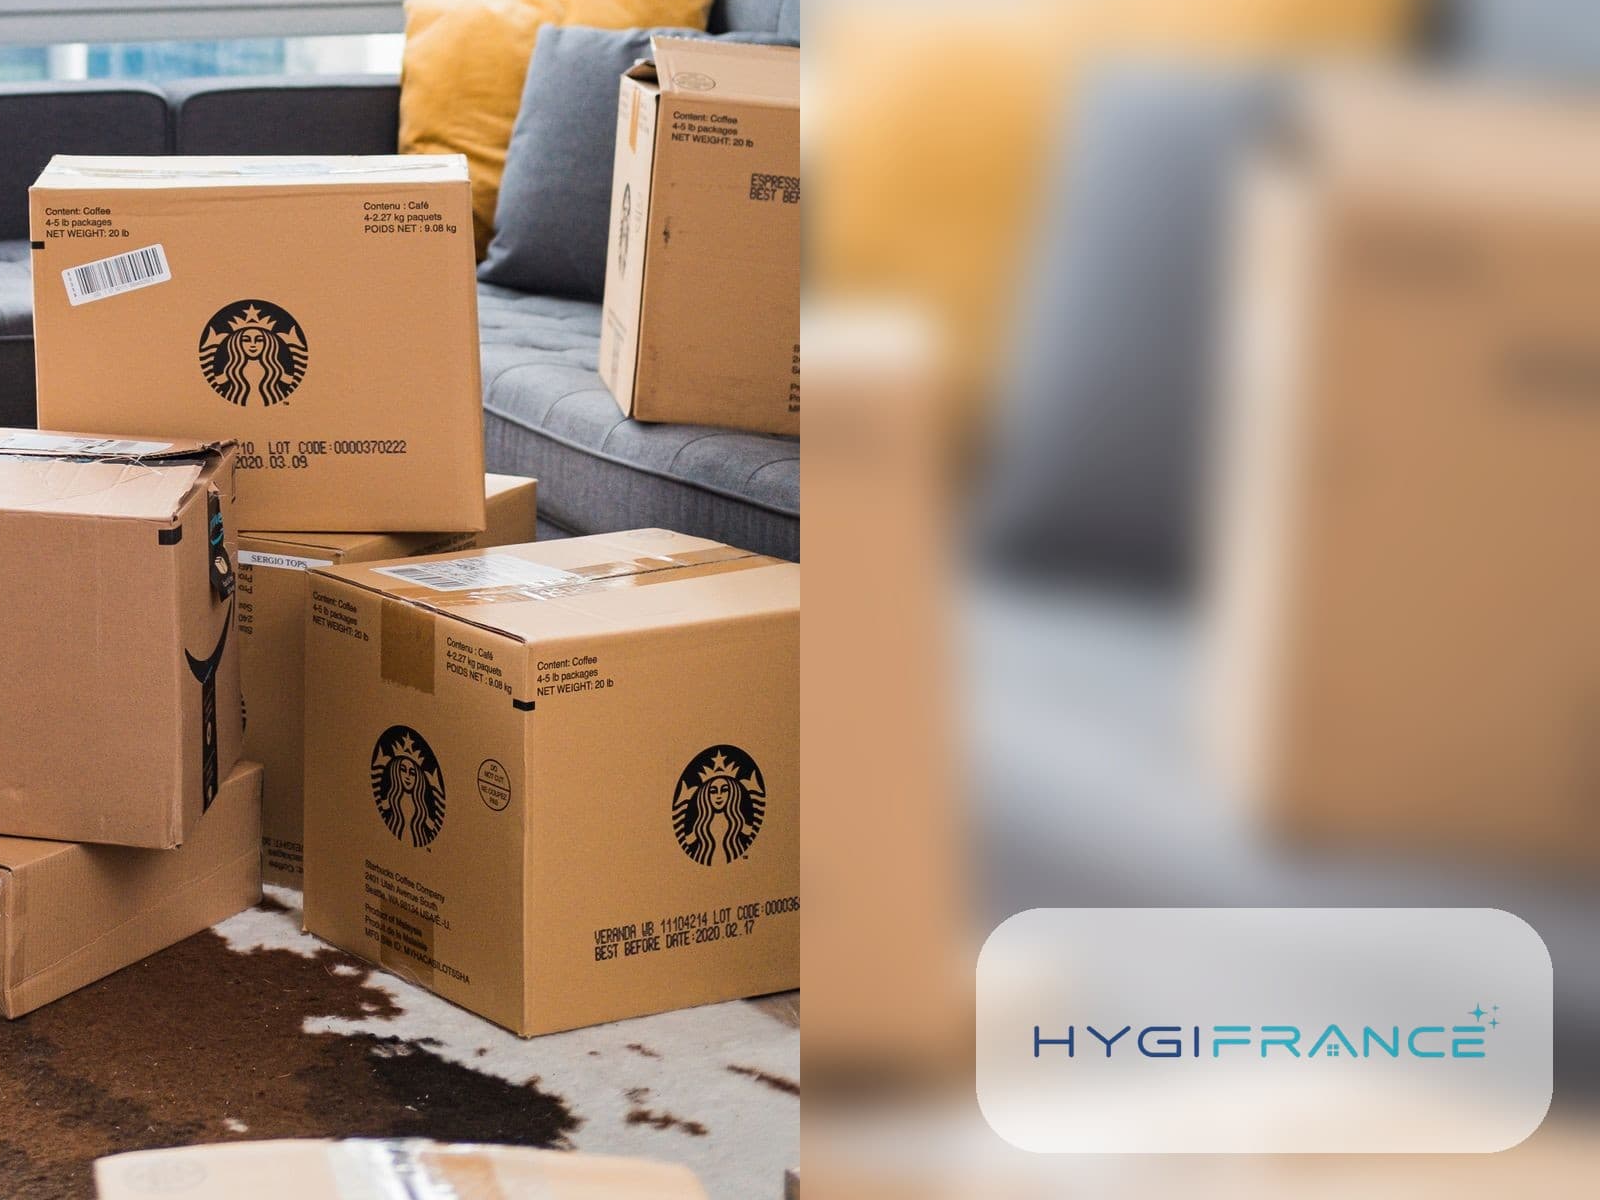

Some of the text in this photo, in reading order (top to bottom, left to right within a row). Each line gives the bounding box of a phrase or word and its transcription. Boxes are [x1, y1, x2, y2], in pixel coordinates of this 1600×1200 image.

[673, 111, 738, 124] Content: Coffee
[688, 123, 695, 132] lb
[698, 125, 738, 135] packages
[672, 133, 690, 141] NET
[733, 138, 743, 147] 20
[746, 139, 754, 148] lb
[750, 173, 800, 190] ESPRESS
[750, 187, 777, 201] BEST
[45, 207, 111, 216] Content: Coffee
[363, 202, 401, 211] Contenu
[408, 201, 429, 210] Café
[45, 219, 112, 228] 4-5 lb packages
[363, 213, 442, 223] 4-2.27 kg paquets
[46, 229, 129, 238] NET WEIGHT: 20 lb
[364, 224, 395, 233] POIDS
[397, 224, 416, 233] NET
[424, 224, 444, 233] 9.08
[446, 224, 457, 234] kg
[268, 441, 290, 455] LOT
[299, 440, 407, 455] CODE:0000370222
[251, 554, 308, 569] SERGIO TOPS
[447, 636, 473, 654] Contenu
[478, 648, 493, 660] Café
[447, 650, 502, 677] 4-2.27 kg paquets
[537, 655, 598, 671] Content: Coffee
[447, 661, 468, 677] POIDS
[470, 670, 483, 682] NET
[489, 677, 503, 690] 9.08
[504, 682, 512, 695] kg
[537, 668, 599, 683] 4-5 lb packages
[537, 677, 614, 697] NET WEIGHT: 20 lb
[395, 872, 415, 888] Coffee
[416, 882, 445, 904] Company
[420, 896, 438, 911] South
[594, 924, 637, 945] VERANDA
[660, 912, 708, 933] 11104214
[713, 908, 731, 925] LOT
[737, 896, 800, 921] CODE:000036
[595, 944, 619, 961] BEST
[624, 936, 661, 957] BEFORE
